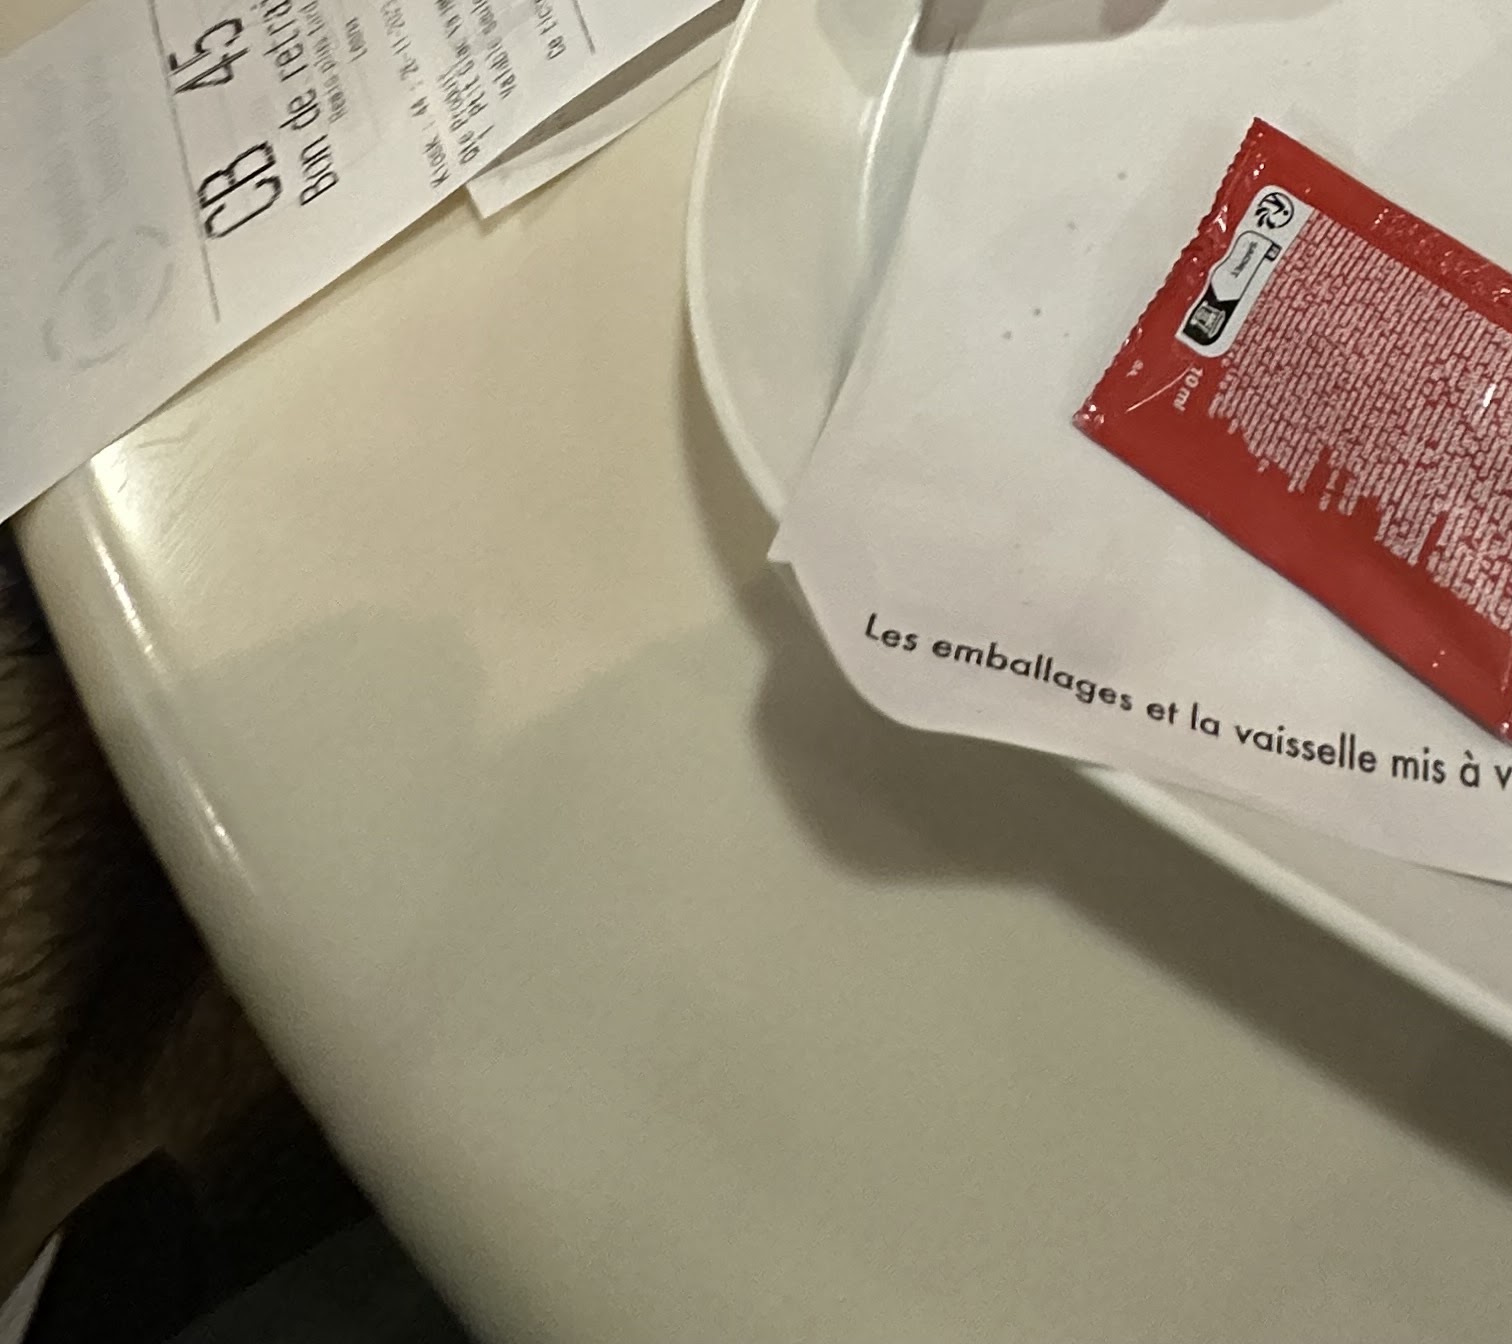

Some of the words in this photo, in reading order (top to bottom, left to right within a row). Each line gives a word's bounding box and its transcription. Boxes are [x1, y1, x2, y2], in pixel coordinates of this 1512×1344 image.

[168, 18, 247, 93] 45
[279, 89, 320, 130] de
[198, 142, 281, 237] CB
[299, 134, 338, 205] Bon
[425, 135, 448, 185] Kiosk
[865, 613, 918, 653] Les
[931, 639, 1134, 712] emballages
[1146, 696, 1181, 726] et
[1190, 701, 1221, 738] la
[1233, 723, 1378, 774] vaisselle
[1391, 748, 1447, 787] mis
[1459, 749, 1480, 788] à
